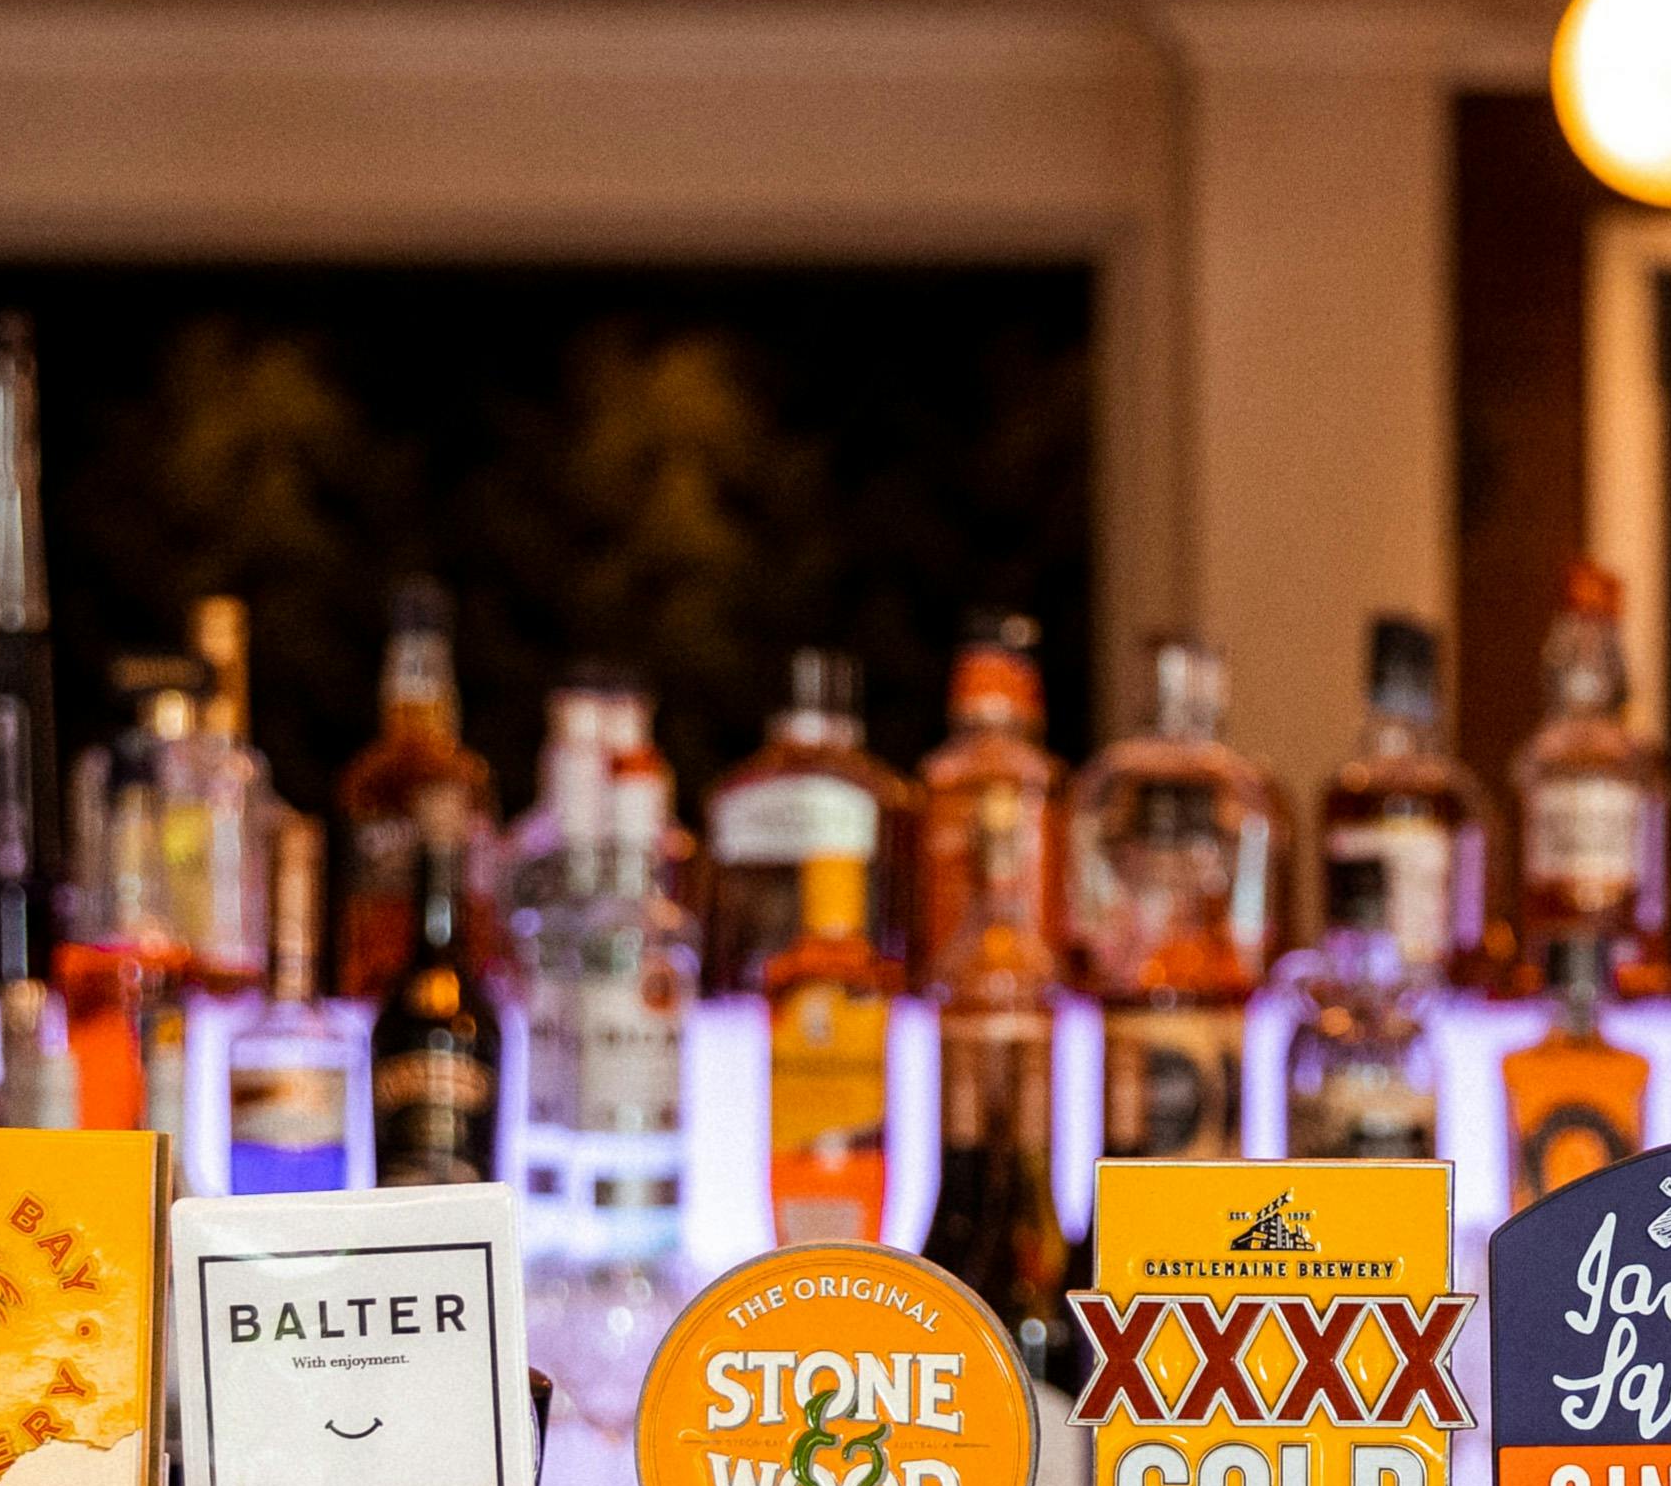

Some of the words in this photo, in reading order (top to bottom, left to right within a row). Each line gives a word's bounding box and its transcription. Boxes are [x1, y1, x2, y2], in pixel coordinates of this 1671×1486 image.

[9, 1191, 97, 1294] BAY
[1145, 1261, 1287, 1278] CASTLEMAINE
[1299, 1262, 1396, 1278] BREWERY
[229, 1294, 466, 1343] BALTER
[728, 1285, 787, 1329] THE
[794, 1275, 939, 1333] ORIGINAL
[292, 1355, 326, 1369] With
[330, 1353, 410, 1370] enjoyment.
[1067, 1290, 1478, 1428] XXXX
[706, 1351, 965, 1434] STONE
